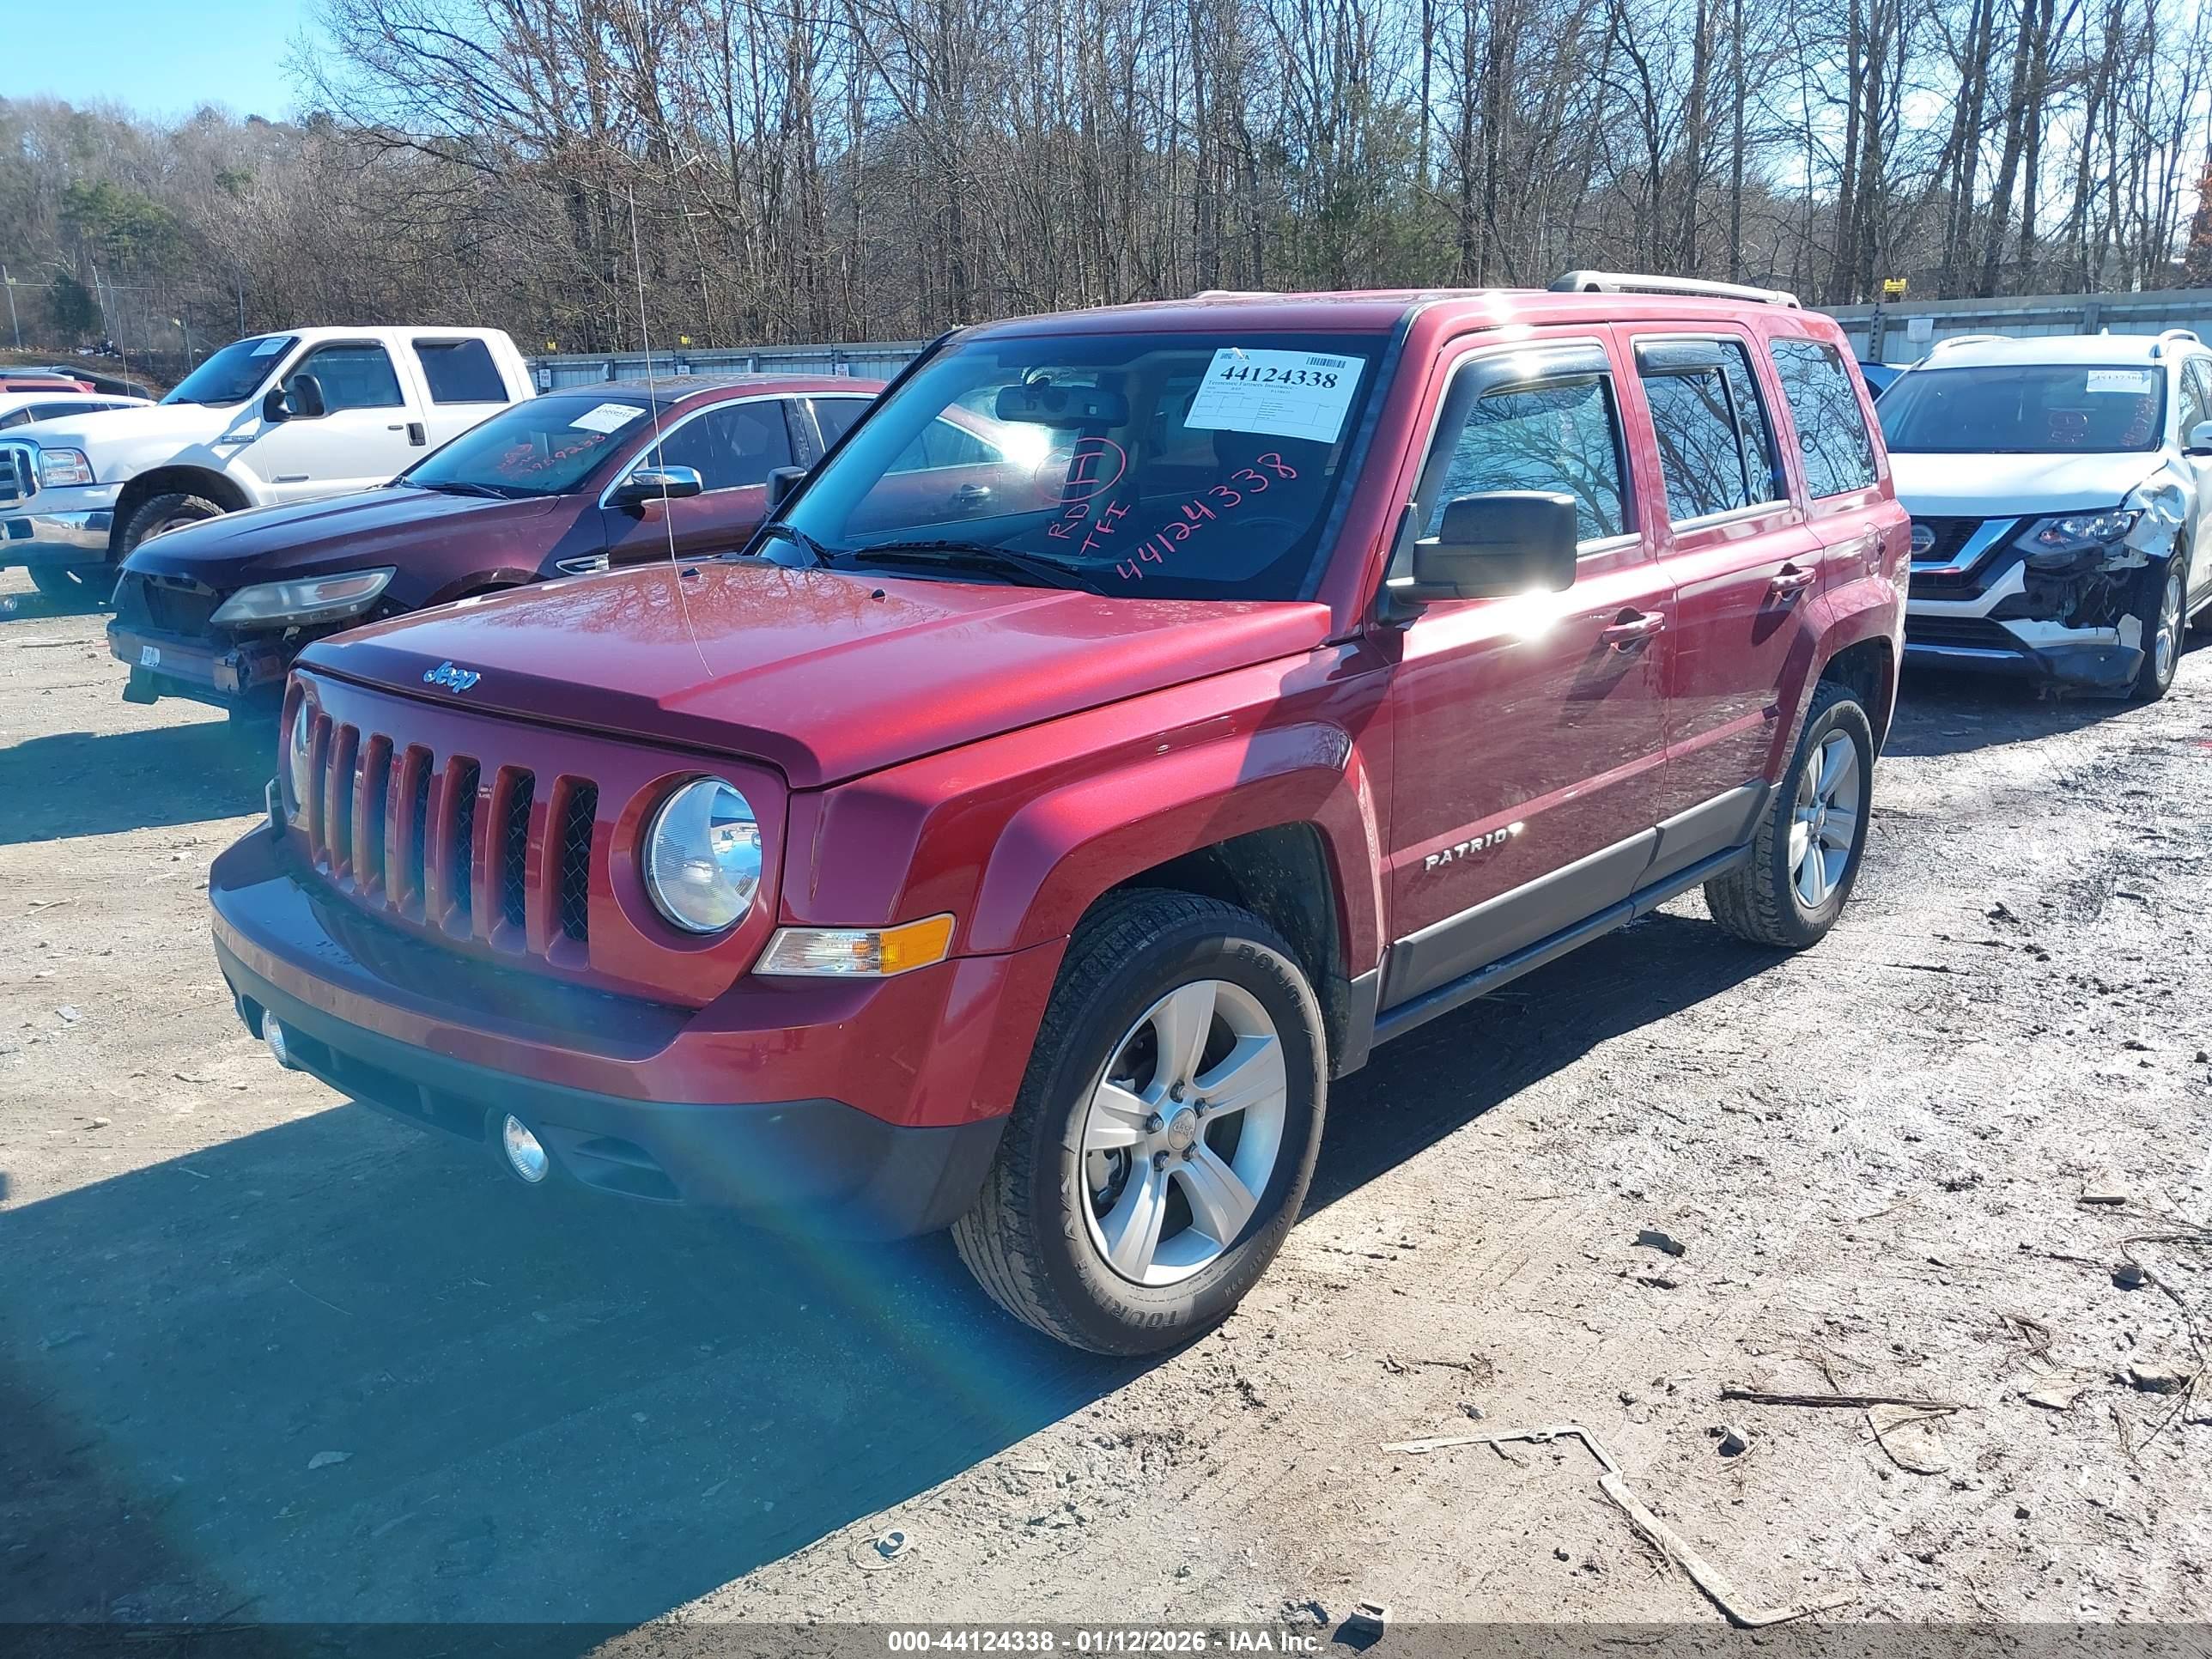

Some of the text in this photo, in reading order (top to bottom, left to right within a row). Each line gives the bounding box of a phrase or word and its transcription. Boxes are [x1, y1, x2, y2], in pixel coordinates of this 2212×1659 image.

[1219, 365, 1339, 389] 44124338
[1116, 452, 1298, 580] 44124338
[423, 660, 481, 694] Jeep
[1075, 1257, 1178, 1329] TOURING
